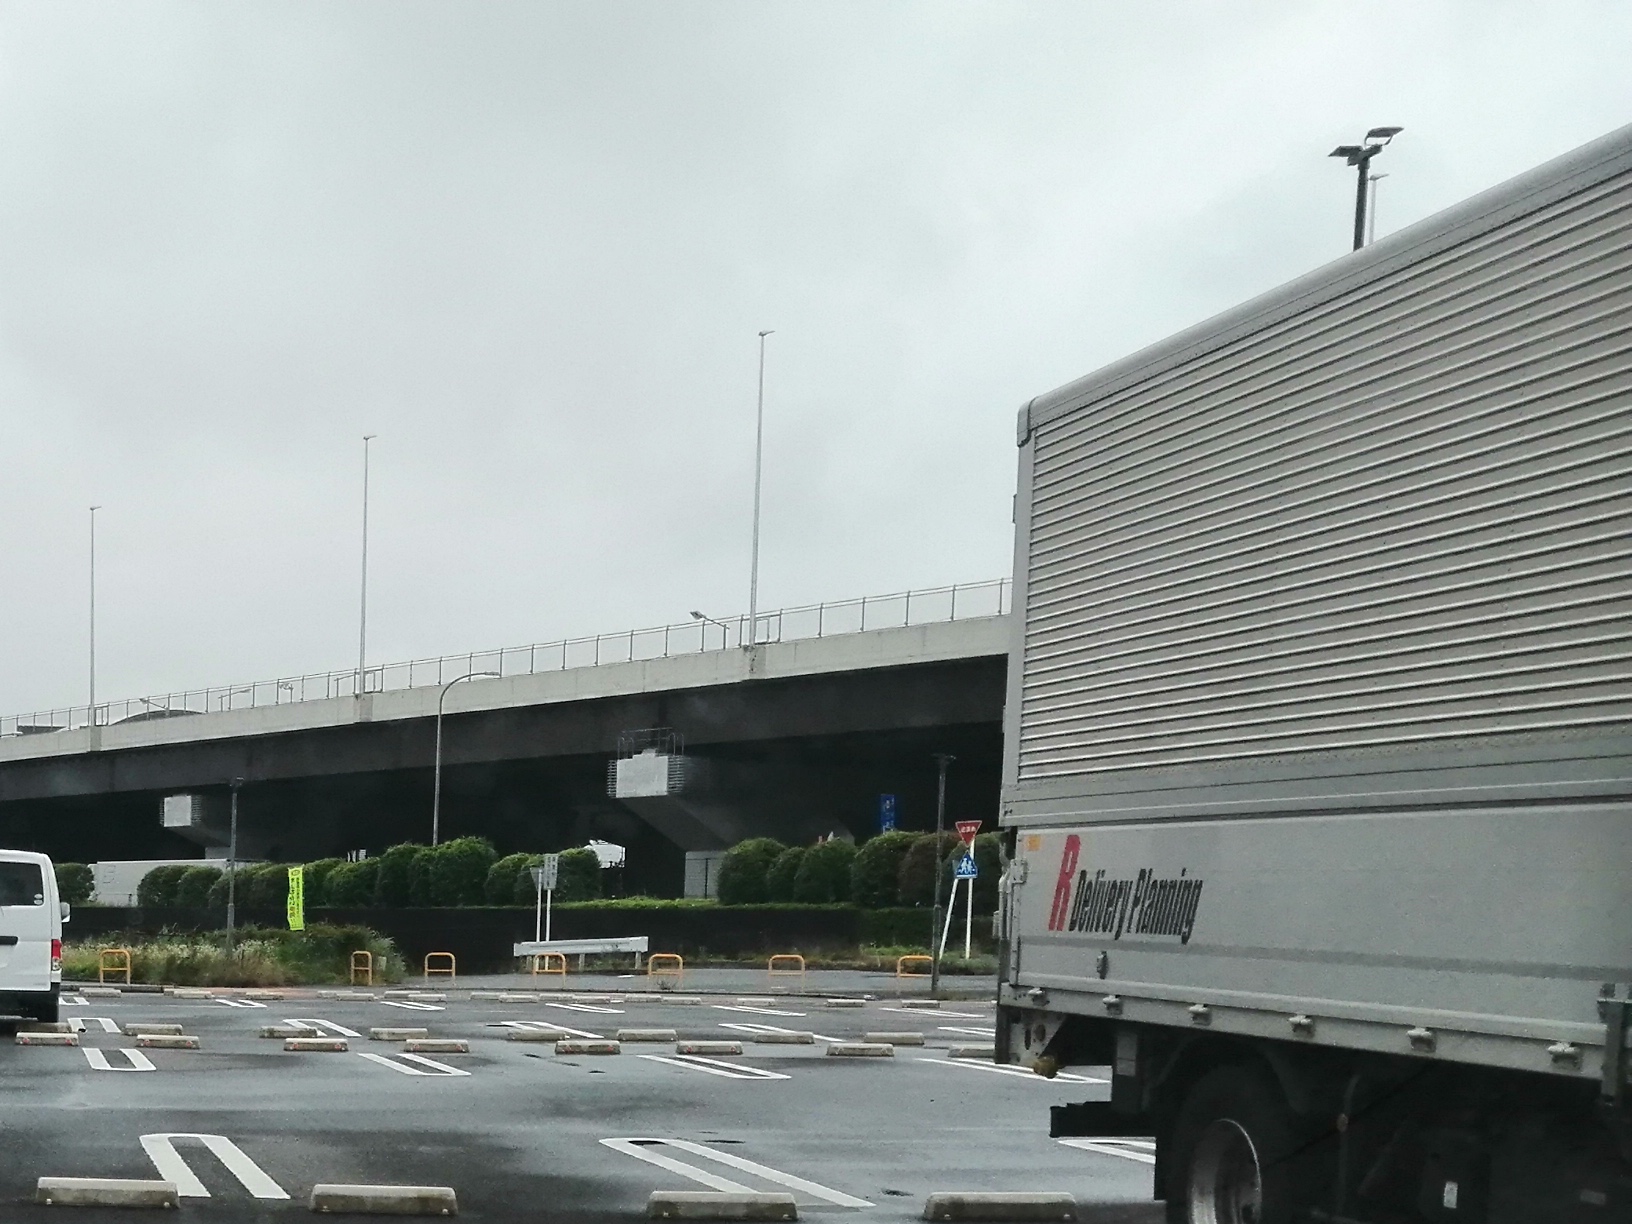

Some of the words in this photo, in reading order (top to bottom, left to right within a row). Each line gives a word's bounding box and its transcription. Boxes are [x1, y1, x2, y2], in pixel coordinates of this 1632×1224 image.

[1048, 834, 1081, 931] R
[1069, 869, 1134, 940] Delivery
[1126, 868, 1204, 945] Planning
